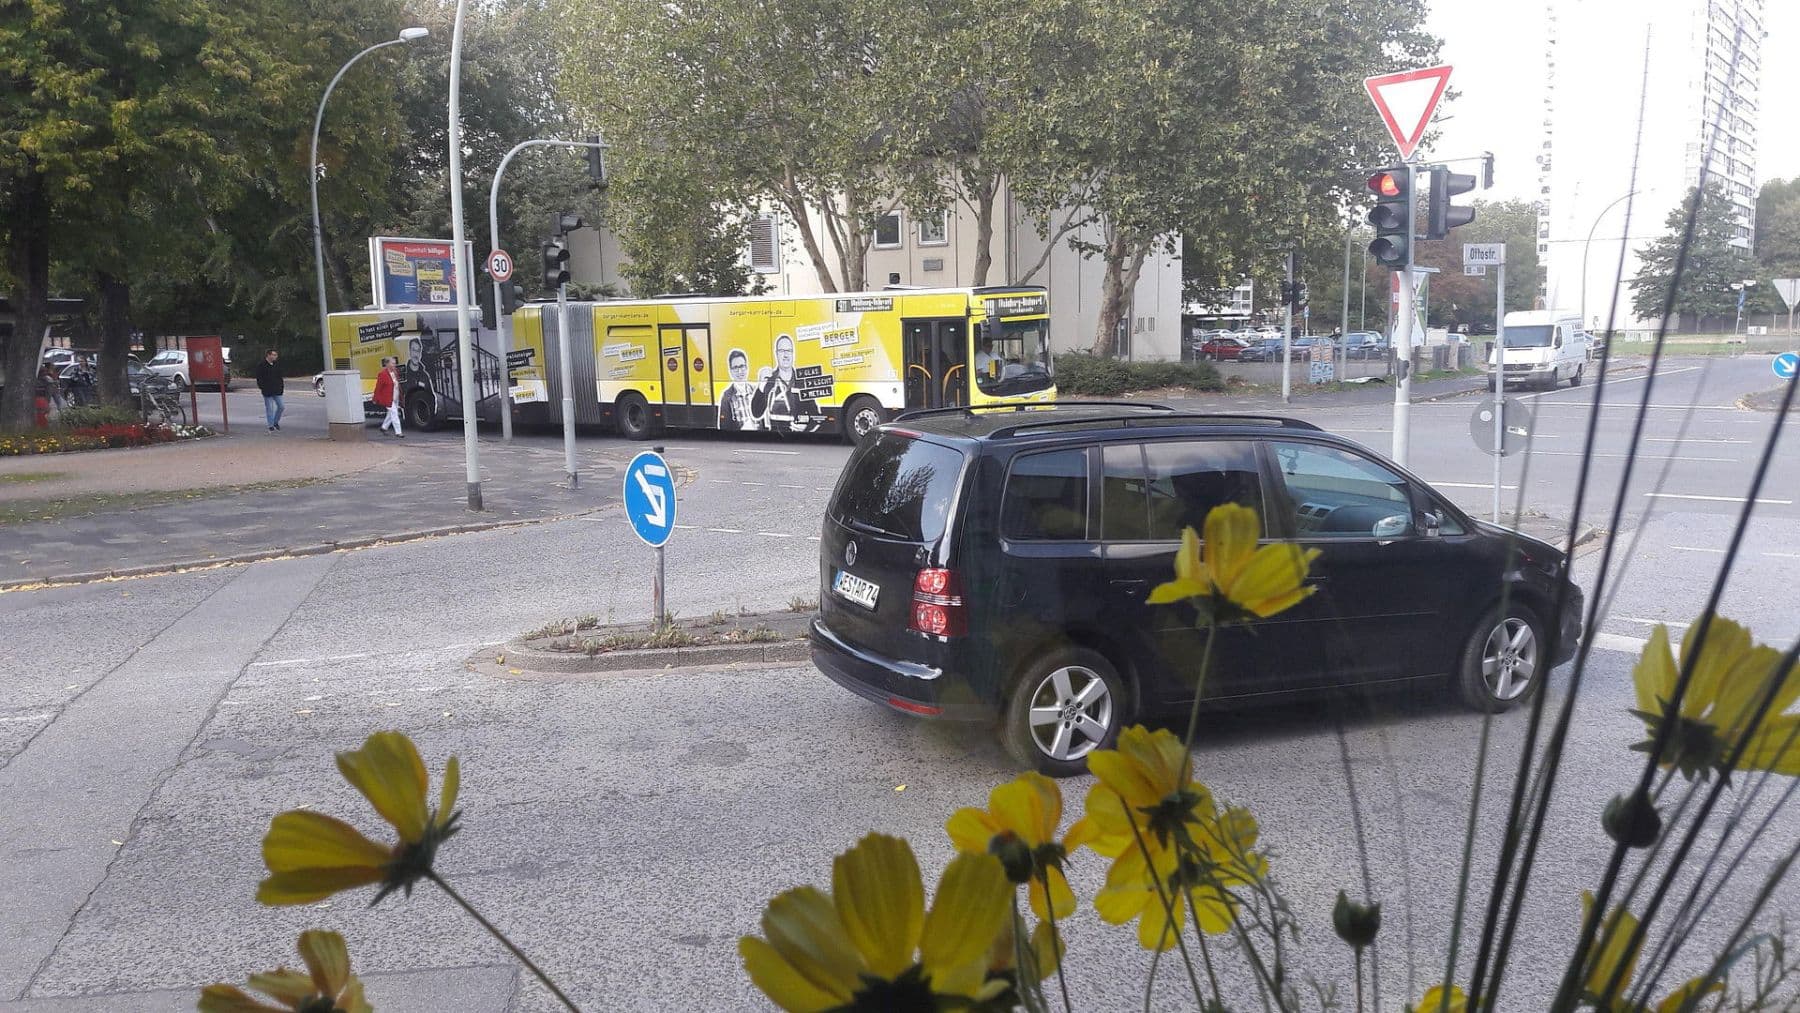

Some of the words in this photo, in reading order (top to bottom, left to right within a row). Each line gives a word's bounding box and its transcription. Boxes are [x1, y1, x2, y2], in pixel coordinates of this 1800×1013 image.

[1470, 247, 1497, 260] Ottostr.
[494, 258, 507, 273] 30
[824, 330, 855, 343] BERGER
[804, 368, 819, 376] GLAS
[813, 377, 832, 385] LICHT
[808, 389, 830, 397] METALL
[866, 584, 879, 603] 74
